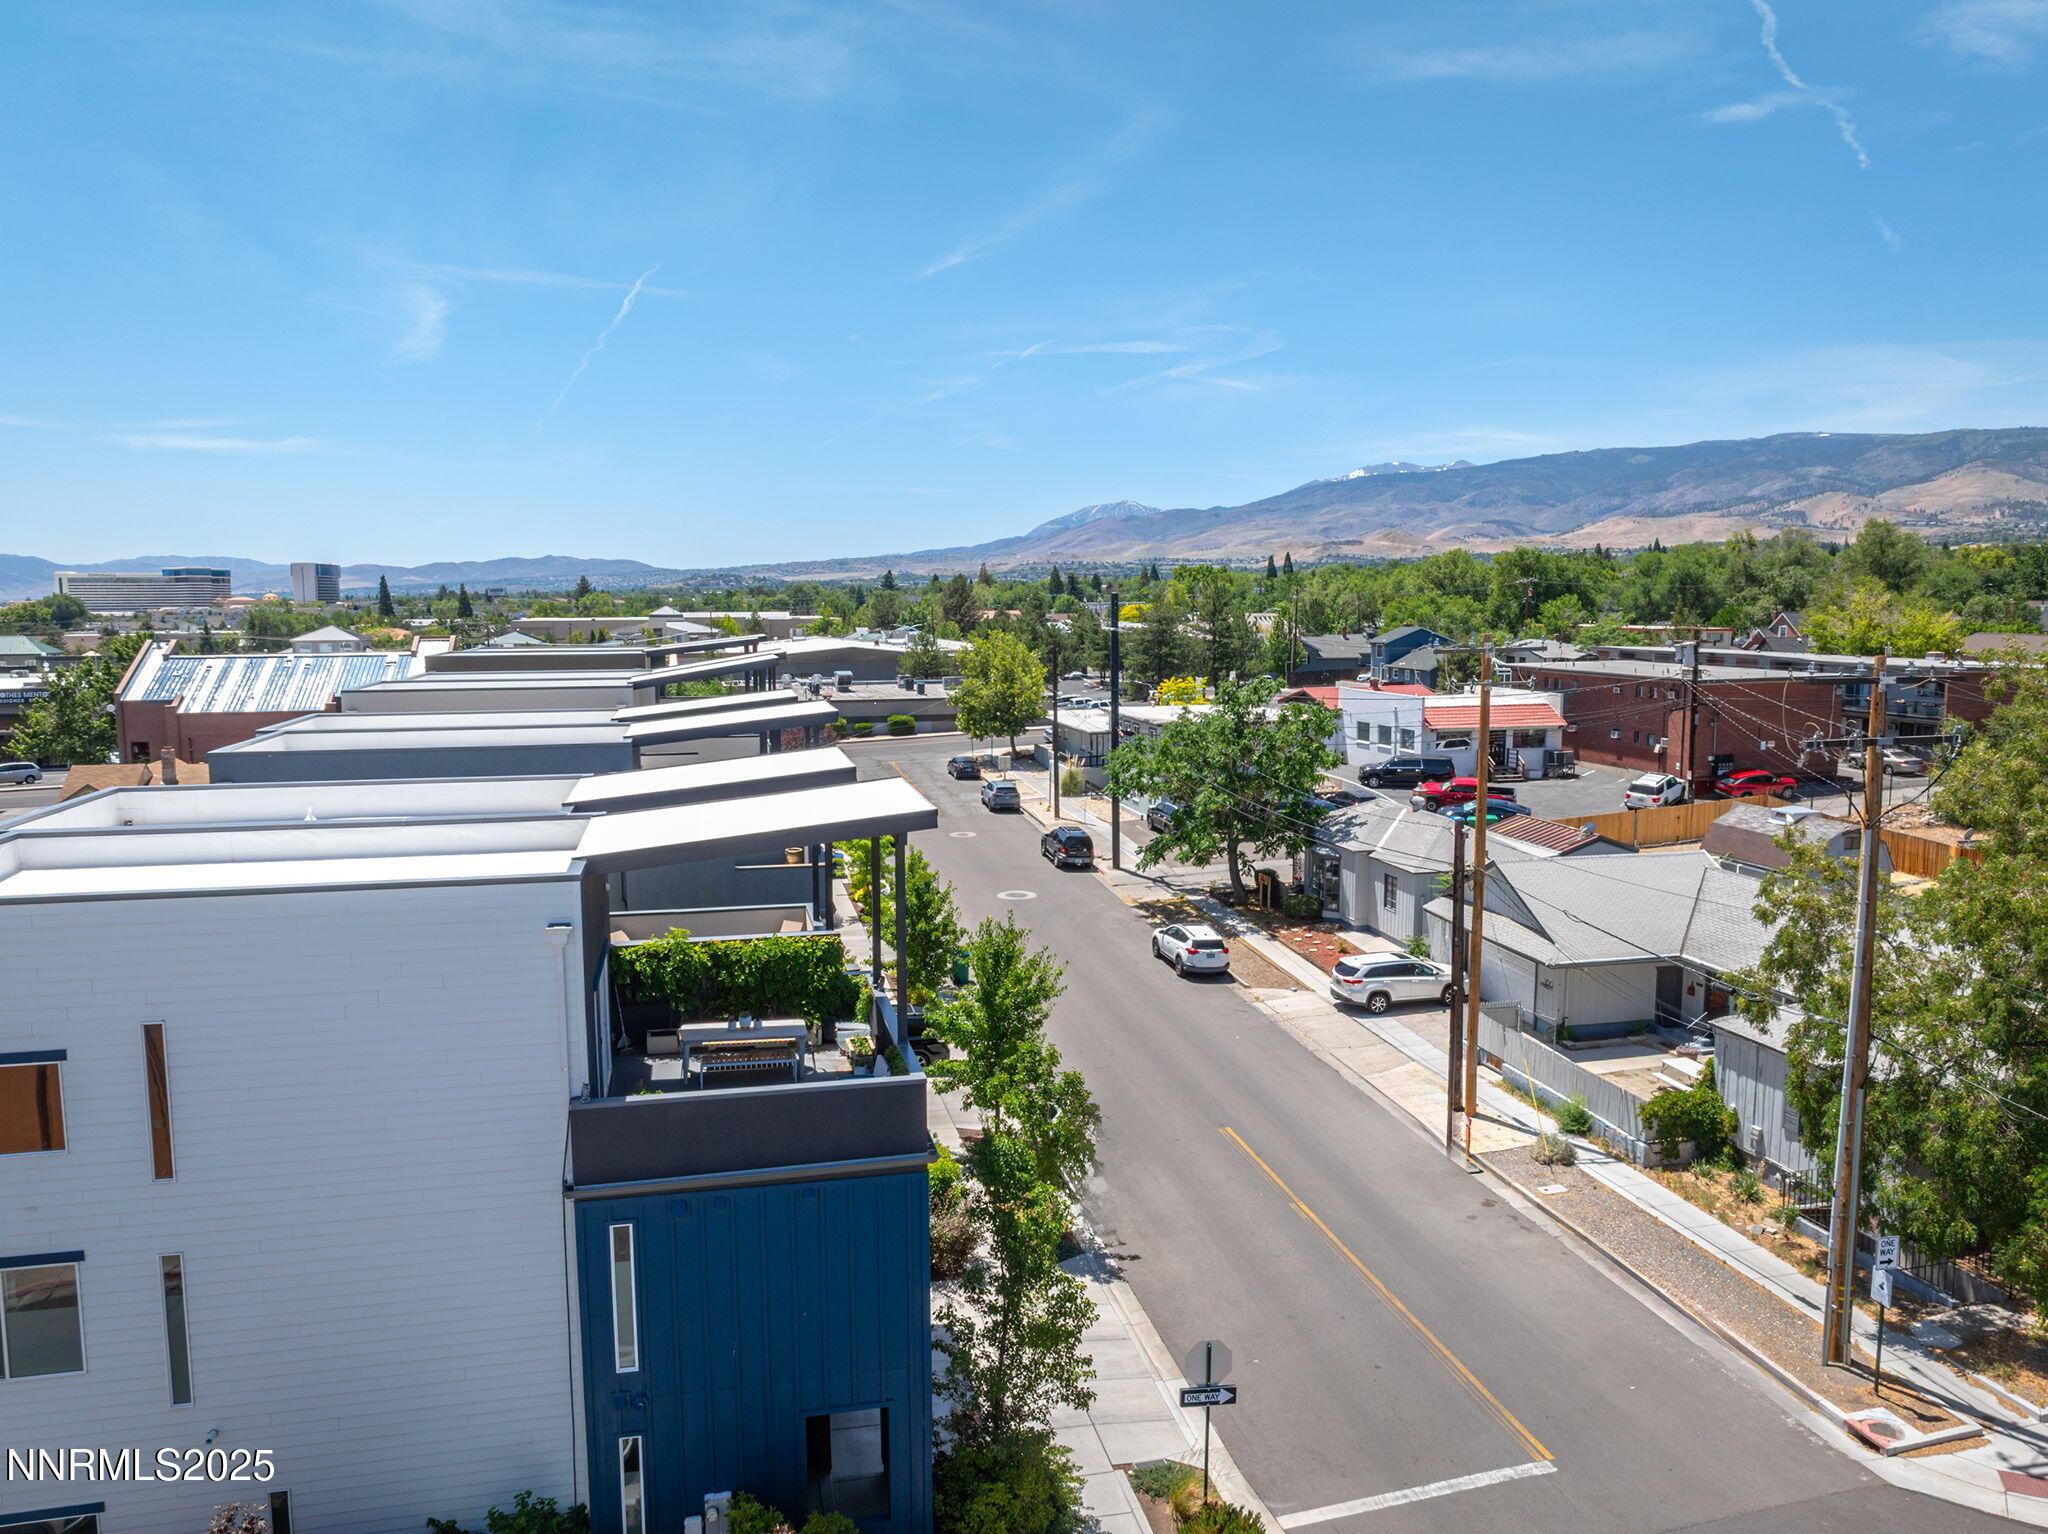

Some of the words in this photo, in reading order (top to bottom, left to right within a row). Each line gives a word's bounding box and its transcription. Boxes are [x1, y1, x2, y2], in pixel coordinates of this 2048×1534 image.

[1881, 1239, 1895, 1248] ONE
[1880, 1248, 1895, 1257] WAY
[1186, 1394, 1202, 1402] ONE
[1204, 1393, 1220, 1401] WAY
